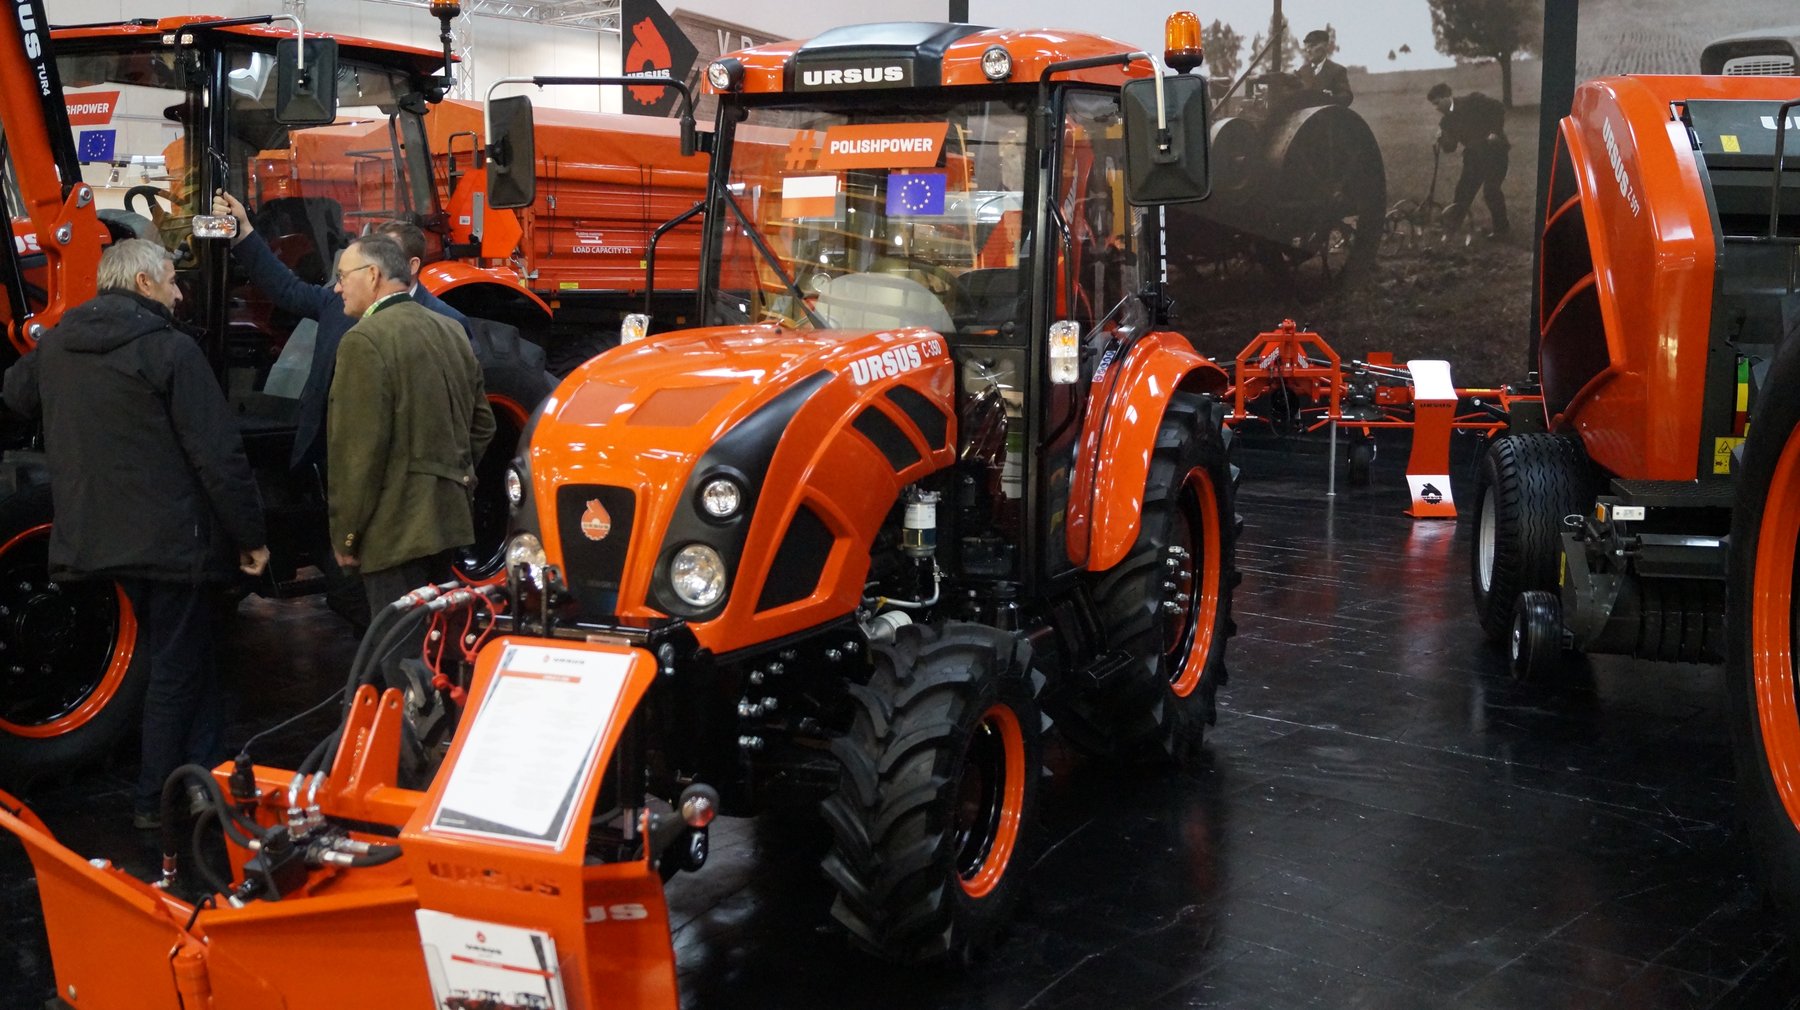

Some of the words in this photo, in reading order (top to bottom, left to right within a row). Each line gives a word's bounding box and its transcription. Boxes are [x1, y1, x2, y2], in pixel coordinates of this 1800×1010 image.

[16, 0, 41, 59] US
[37, 62, 51, 96] TUR4
[803, 66, 904, 86] URSUS
[830, 138, 934, 155] POLISHPOWER
[1602, 116, 1629, 198] URSUS
[572, 245, 591, 254] LOAD
[849, 344, 922, 386] URSUS
